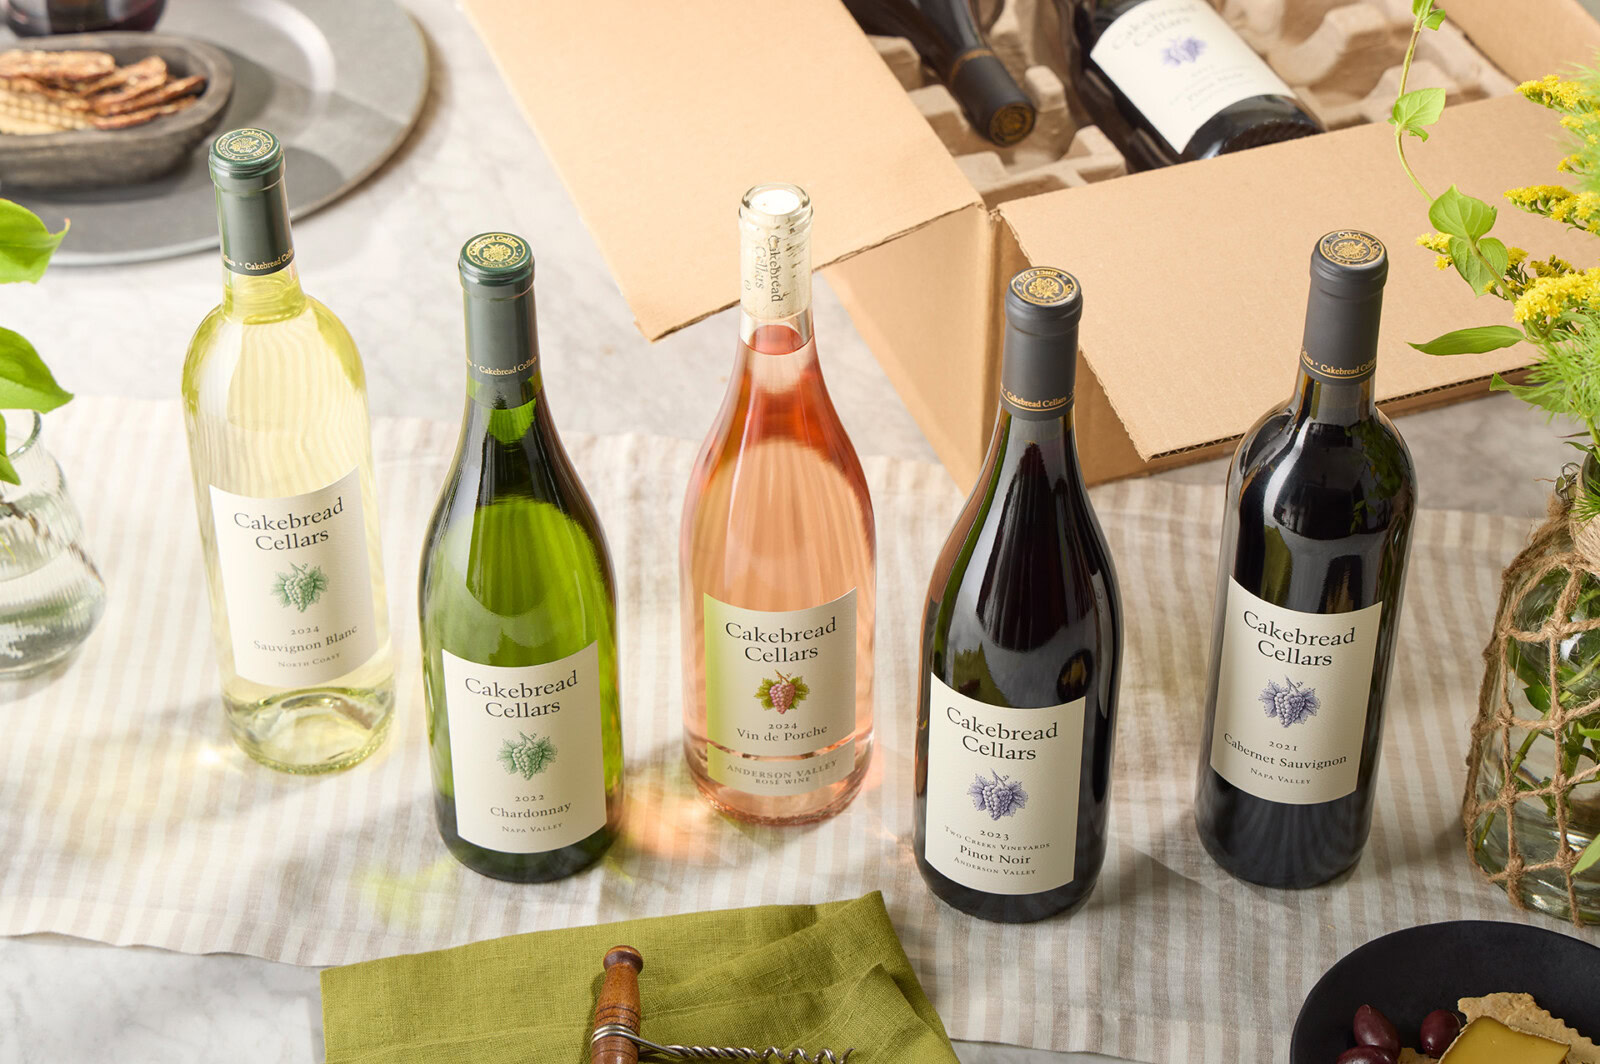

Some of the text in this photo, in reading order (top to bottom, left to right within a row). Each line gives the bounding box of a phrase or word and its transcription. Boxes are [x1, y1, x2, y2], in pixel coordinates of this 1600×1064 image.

[244, 257, 281, 270] Cakebread
[478, 365, 517, 376] Cakebread
[1320, 364, 1360, 375] Cakebread
[1006, 391, 1067, 408] Cakebread Cellars
[233, 496, 344, 531] Cakebread
[255, 529, 329, 551] Cellars
[290, 625, 320, 636] 2024
[725, 616, 837, 644] Cakebread
[1243, 610, 1356, 647] Cakebread
[254, 625, 358, 654] Sauvignon Blanc
[744, 646, 819, 663] Cellars
[1257, 639, 1333, 667] Cellars
[465, 669, 578, 699] Cakebread
[485, 701, 561, 719] Cellars
[768, 722, 798, 730] 2024
[946, 706, 1058, 741] Cakebread
[737, 725, 828, 742] Vin de Porche
[962, 735, 1037, 761] Cellars
[1223, 732, 1347, 771] Cabernet Sauvignon
[1268, 740, 1298, 752] 2021
[727, 759, 838, 779] ANDERSON VALLEY
[784, 776, 810, 785] WINE
[515, 794, 545, 802] 2022
[490, 802, 572, 819] Chardonnay
[979, 829, 1010, 841] 2023
[959, 844, 1031, 865] Pinot Noir
